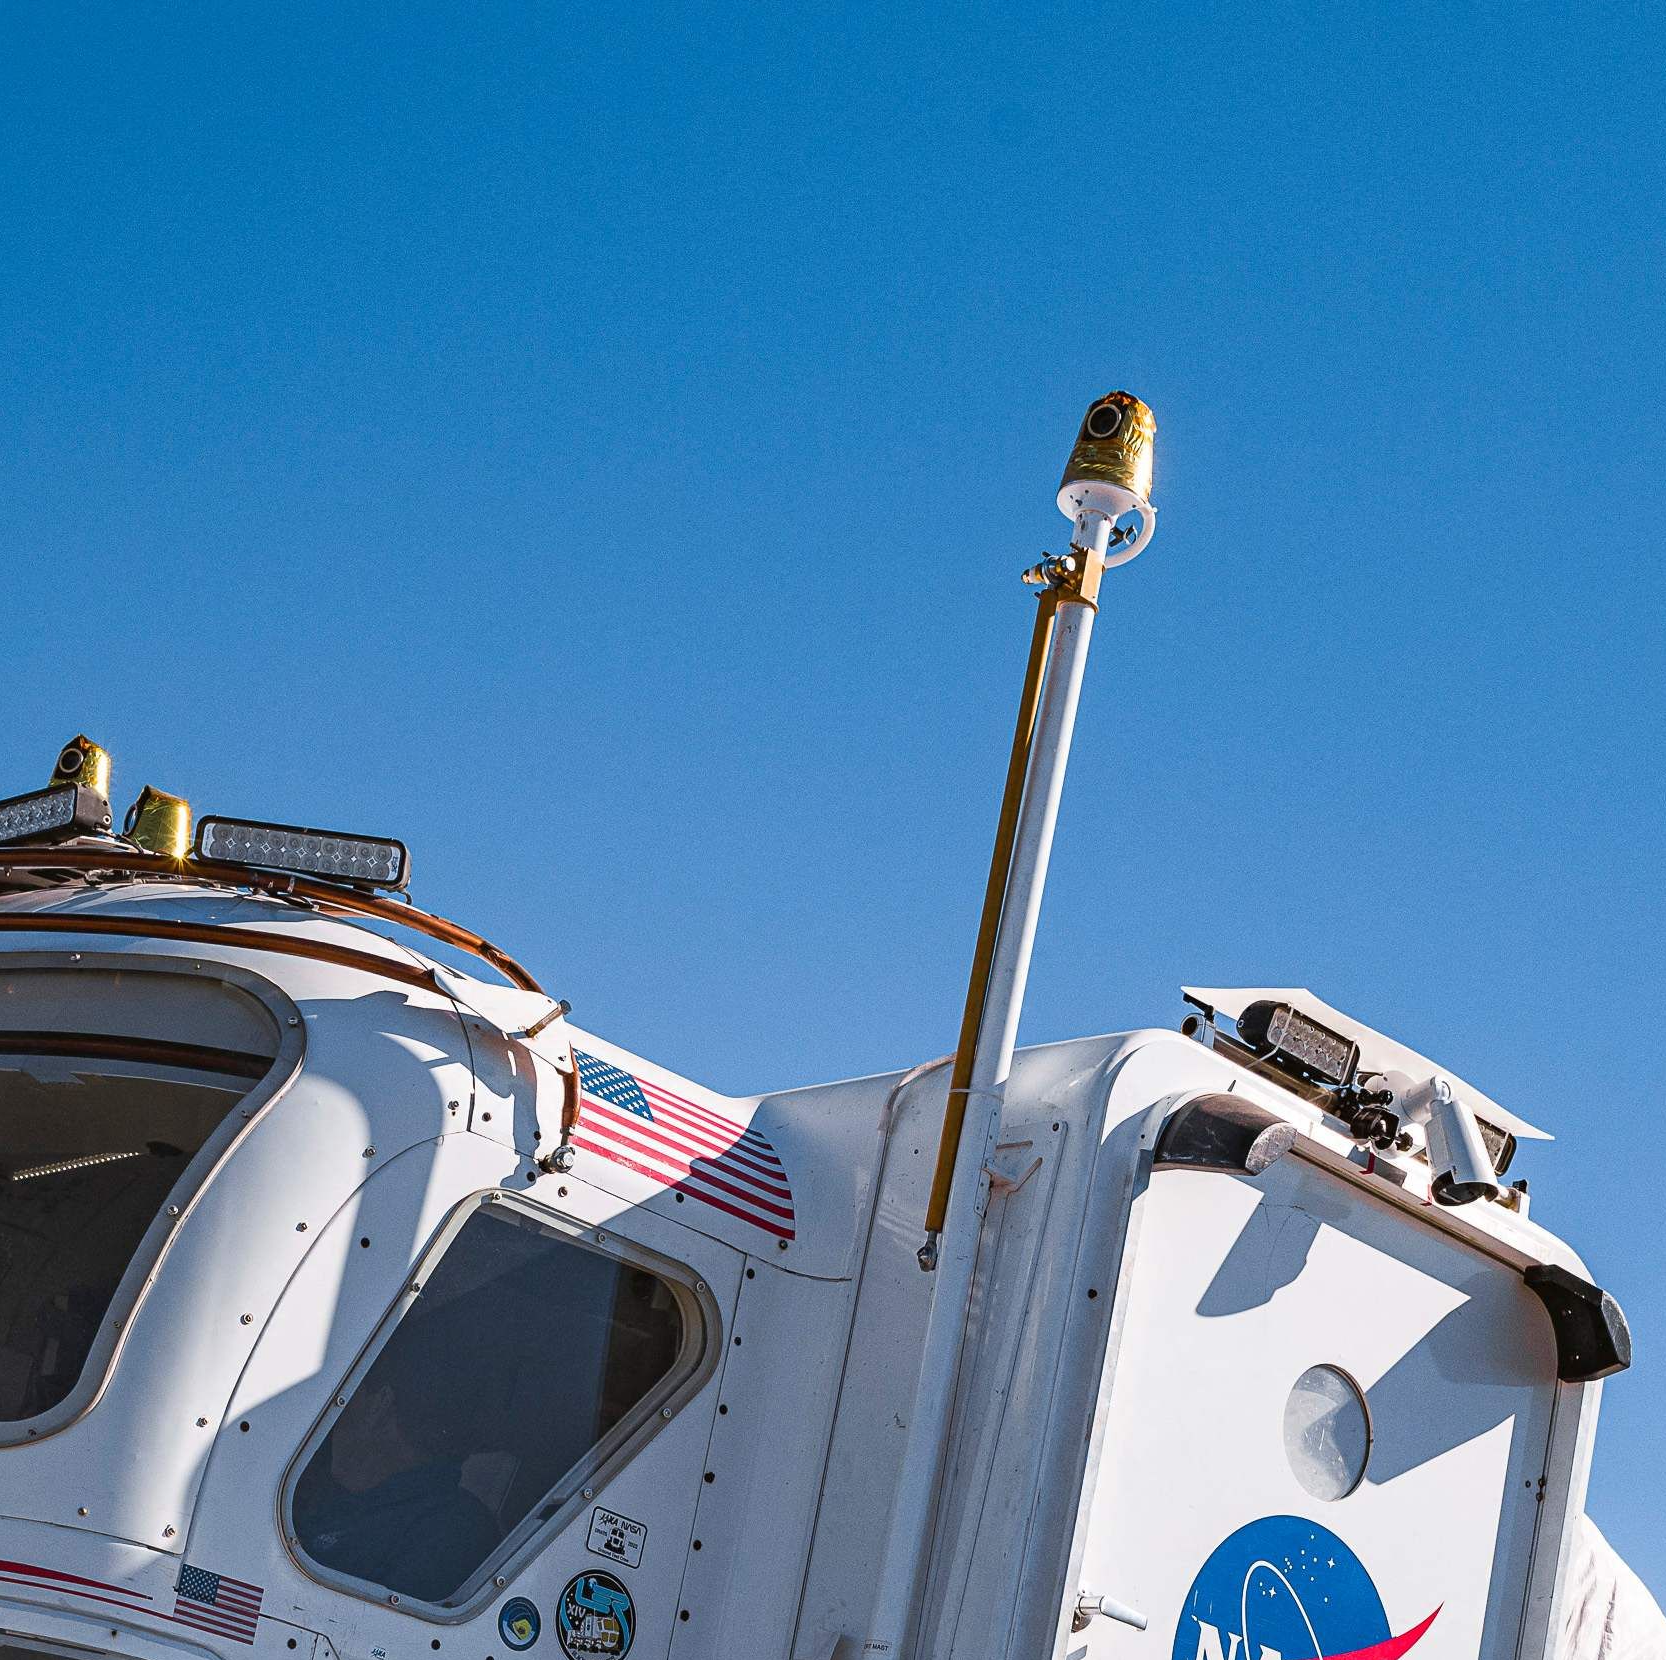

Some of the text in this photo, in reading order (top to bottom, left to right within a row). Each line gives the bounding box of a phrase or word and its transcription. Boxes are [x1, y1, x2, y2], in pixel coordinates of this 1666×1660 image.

[621, 1521, 642, 1536] NASA
[567, 1603, 586, 1618] XIV
[872, 1643, 889, 1651] MAST
